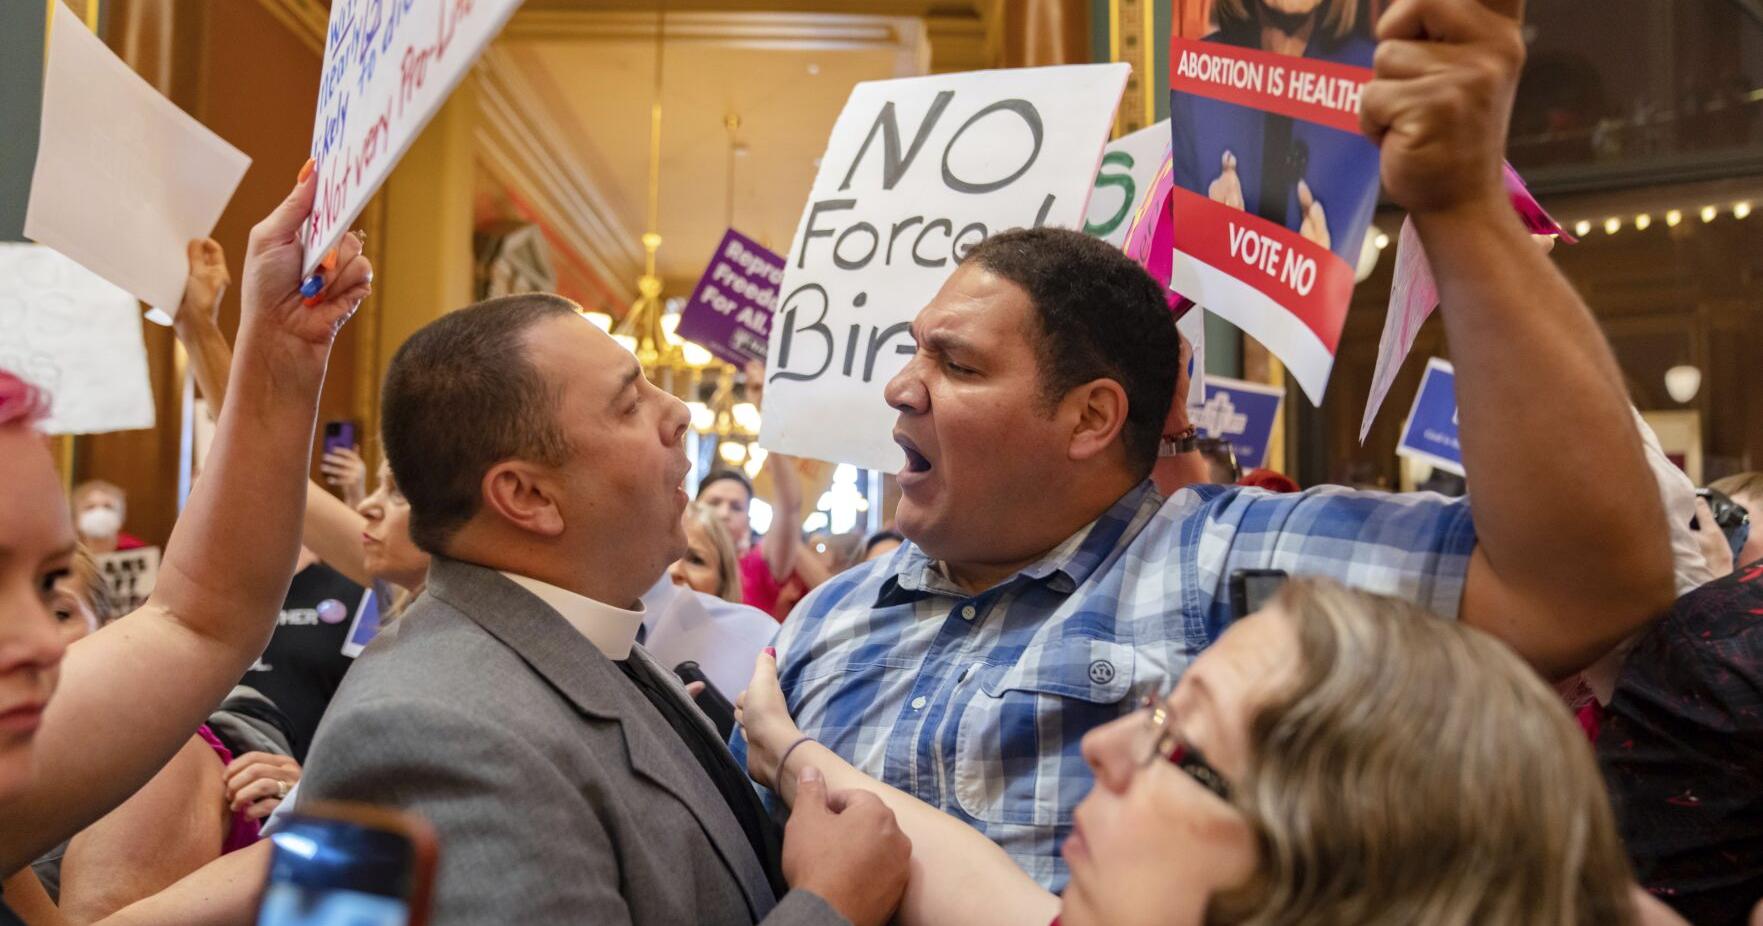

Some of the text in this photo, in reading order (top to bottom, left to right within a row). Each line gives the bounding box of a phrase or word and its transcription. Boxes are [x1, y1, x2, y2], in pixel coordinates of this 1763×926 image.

[399, 0, 475, 119] Pro-L
[1177, 50, 1365, 114] ABORTION IS HEALTH
[838, 90, 1044, 194] NO
[797, 193, 1056, 271] Force
[1229, 222, 1317, 296] VOTE NO
[700, 284, 768, 337] For All.
